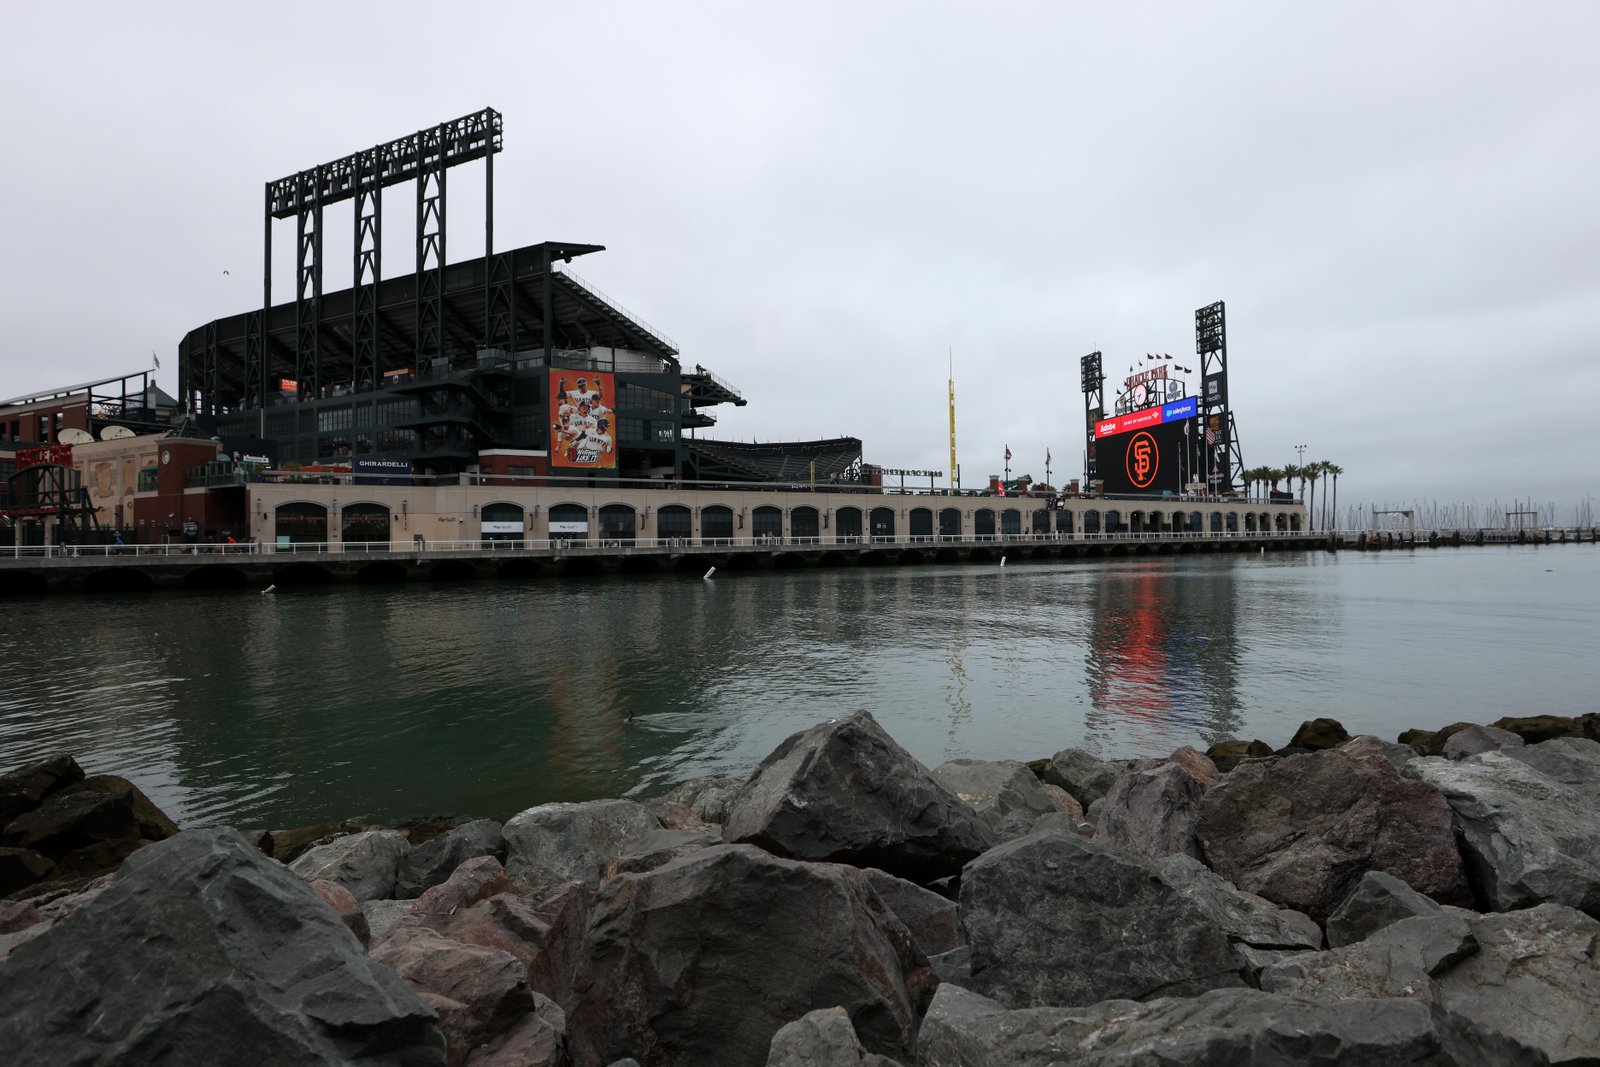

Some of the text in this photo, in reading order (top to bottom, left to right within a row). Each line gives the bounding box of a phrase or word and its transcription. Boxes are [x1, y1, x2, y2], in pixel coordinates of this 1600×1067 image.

[1151, 364, 1168, 380] PARK
[1172, 405, 1191, 415] salesforce
[1100, 422, 1116, 432] Adobe
[359, 460, 408, 468] GHIRARDELLI
